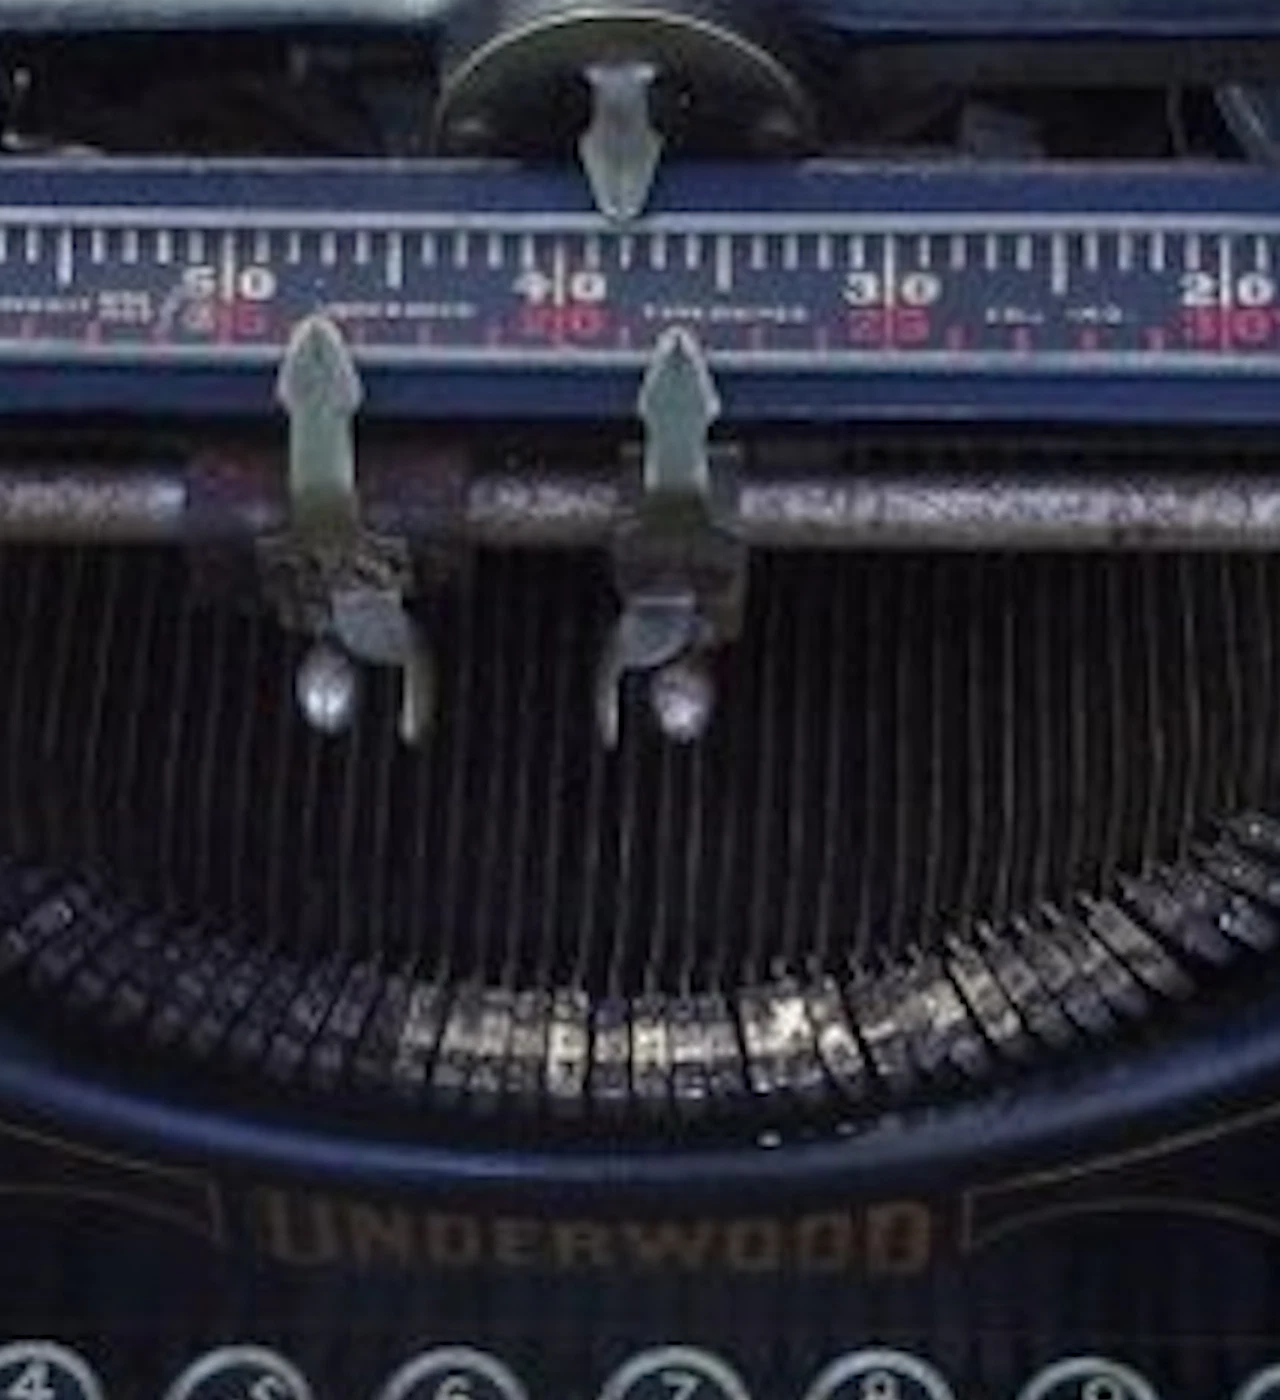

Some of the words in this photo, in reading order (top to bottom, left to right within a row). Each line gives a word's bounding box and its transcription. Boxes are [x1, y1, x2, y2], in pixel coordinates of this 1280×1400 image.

[182, 266, 277, 300] 50
[511, 272, 606, 304] 40
[843, 273, 940, 306] 30
[1179, 273, 1275, 306] 20
[261, 1187, 932, 1274] UNDERWOOD
